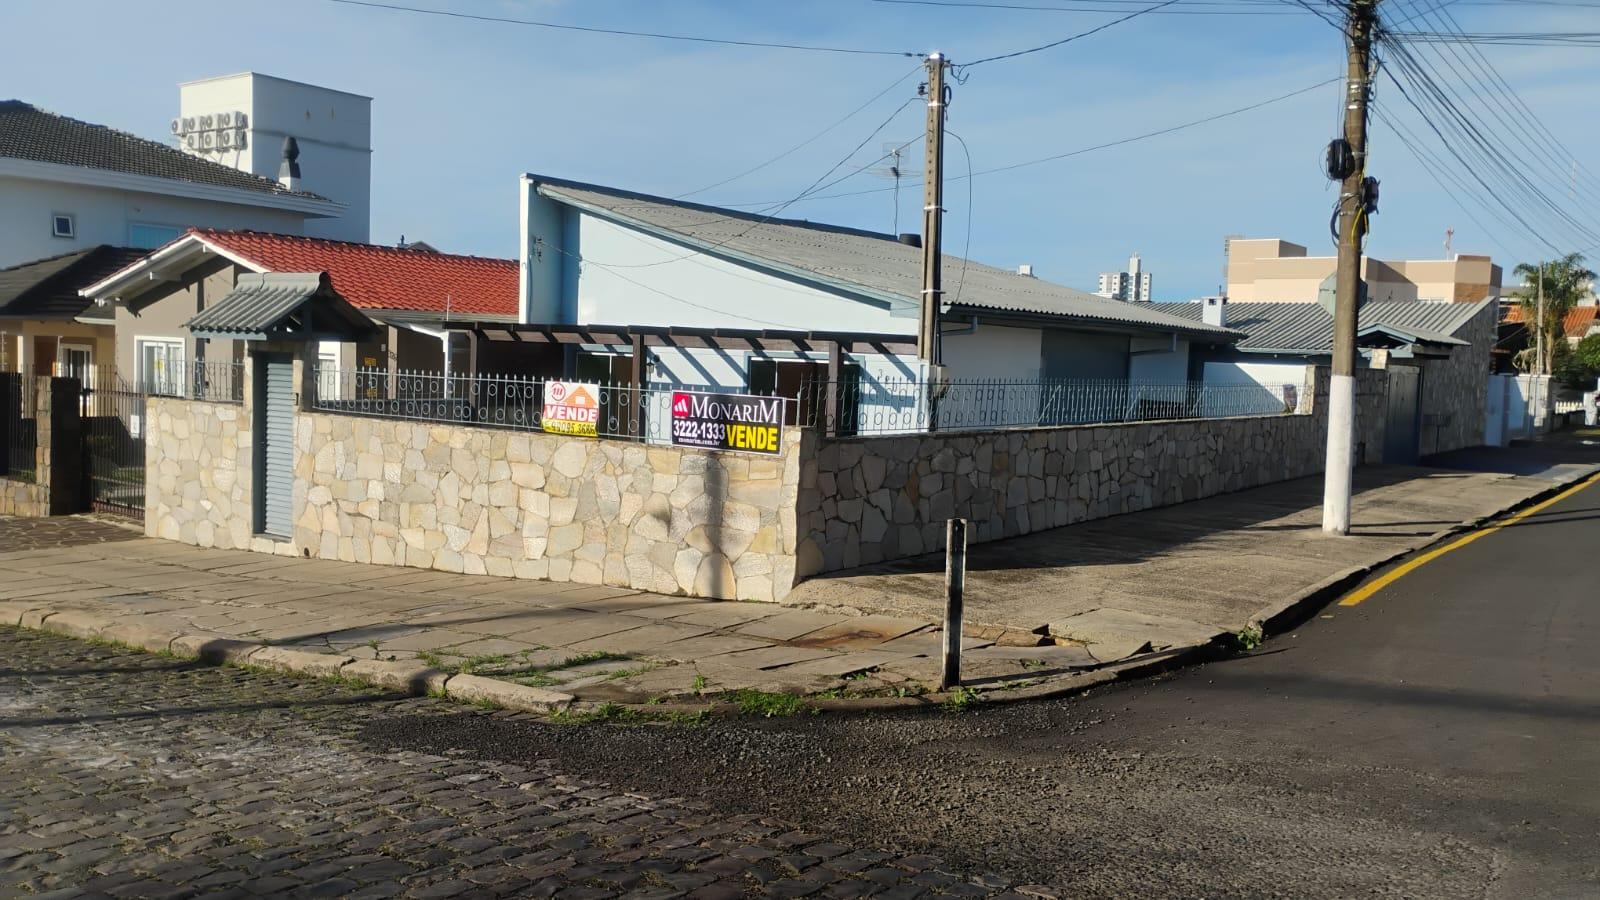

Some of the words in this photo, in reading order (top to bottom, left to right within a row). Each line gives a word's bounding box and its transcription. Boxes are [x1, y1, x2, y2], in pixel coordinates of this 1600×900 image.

[546, 405, 597, 422] VENDE
[673, 420, 725, 440] 3222-1333
[726, 424, 778, 451] VENDE
